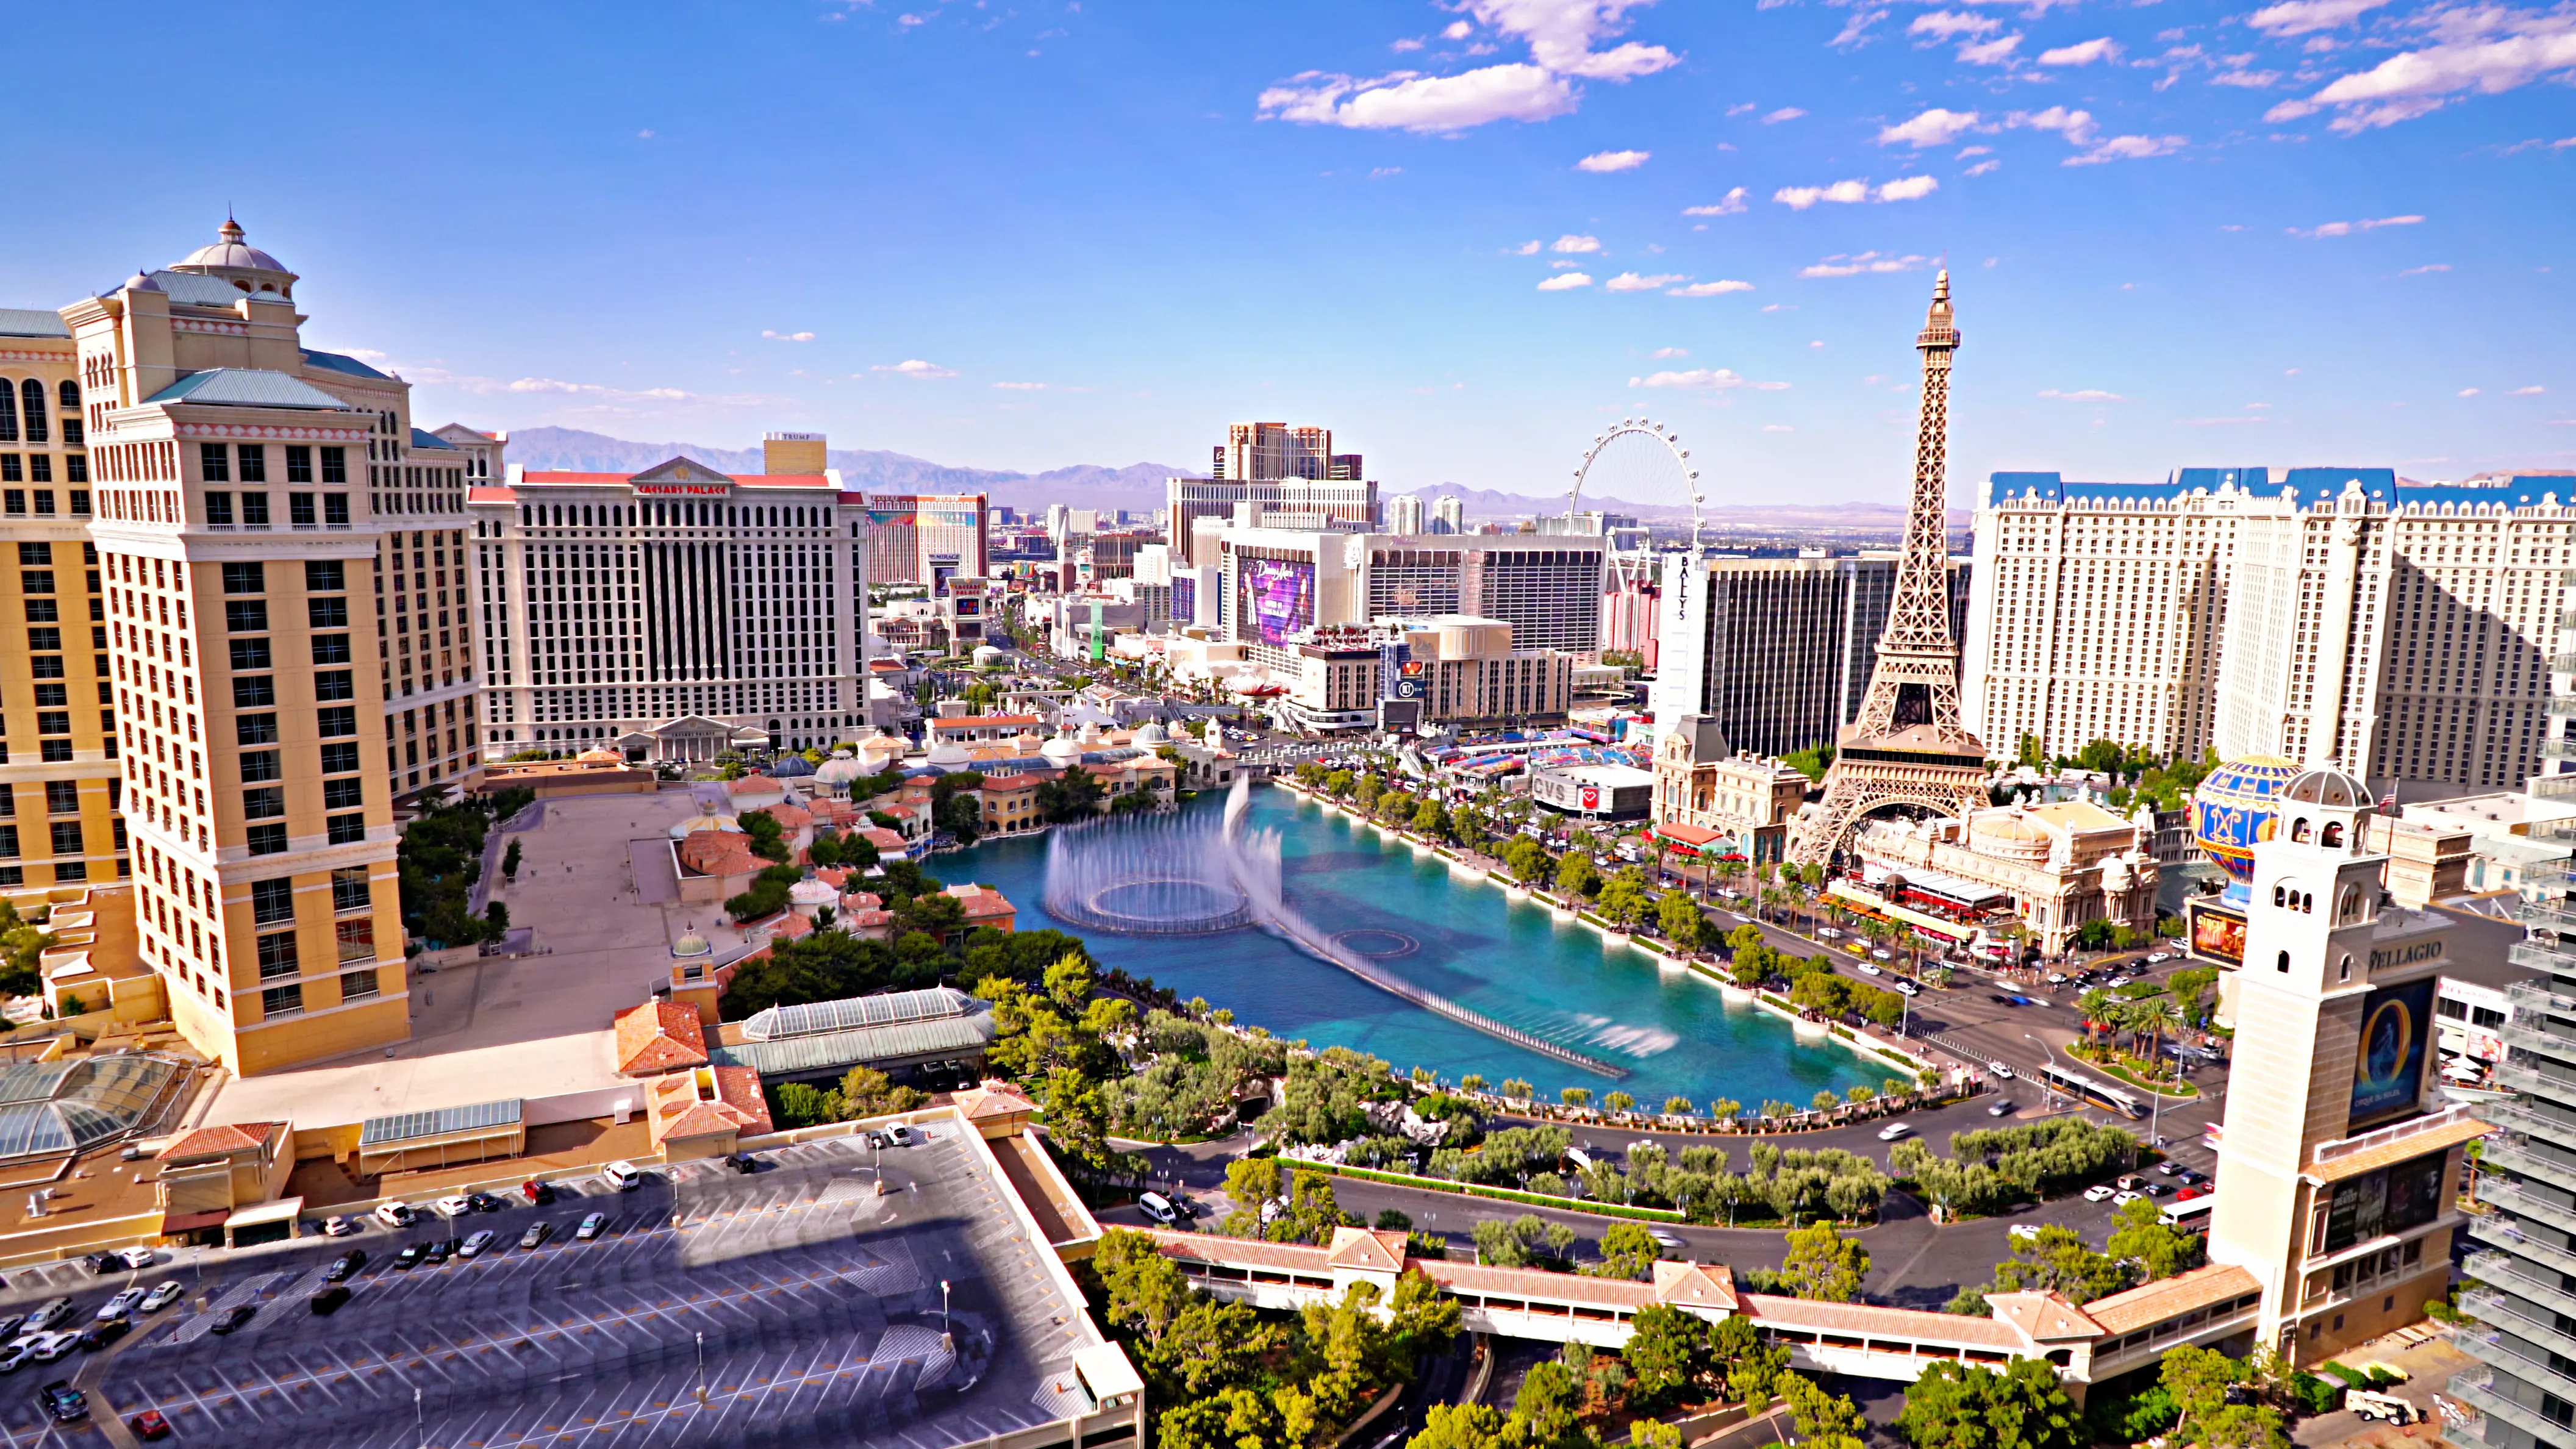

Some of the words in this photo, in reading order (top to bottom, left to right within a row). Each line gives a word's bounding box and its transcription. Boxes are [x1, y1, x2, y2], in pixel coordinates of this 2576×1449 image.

[638, 485, 683, 494] CAESARS
[687, 485, 726, 494] PALACE
[1534, 778, 1565, 801] CVS
[2357, 999, 2412, 1089] O
